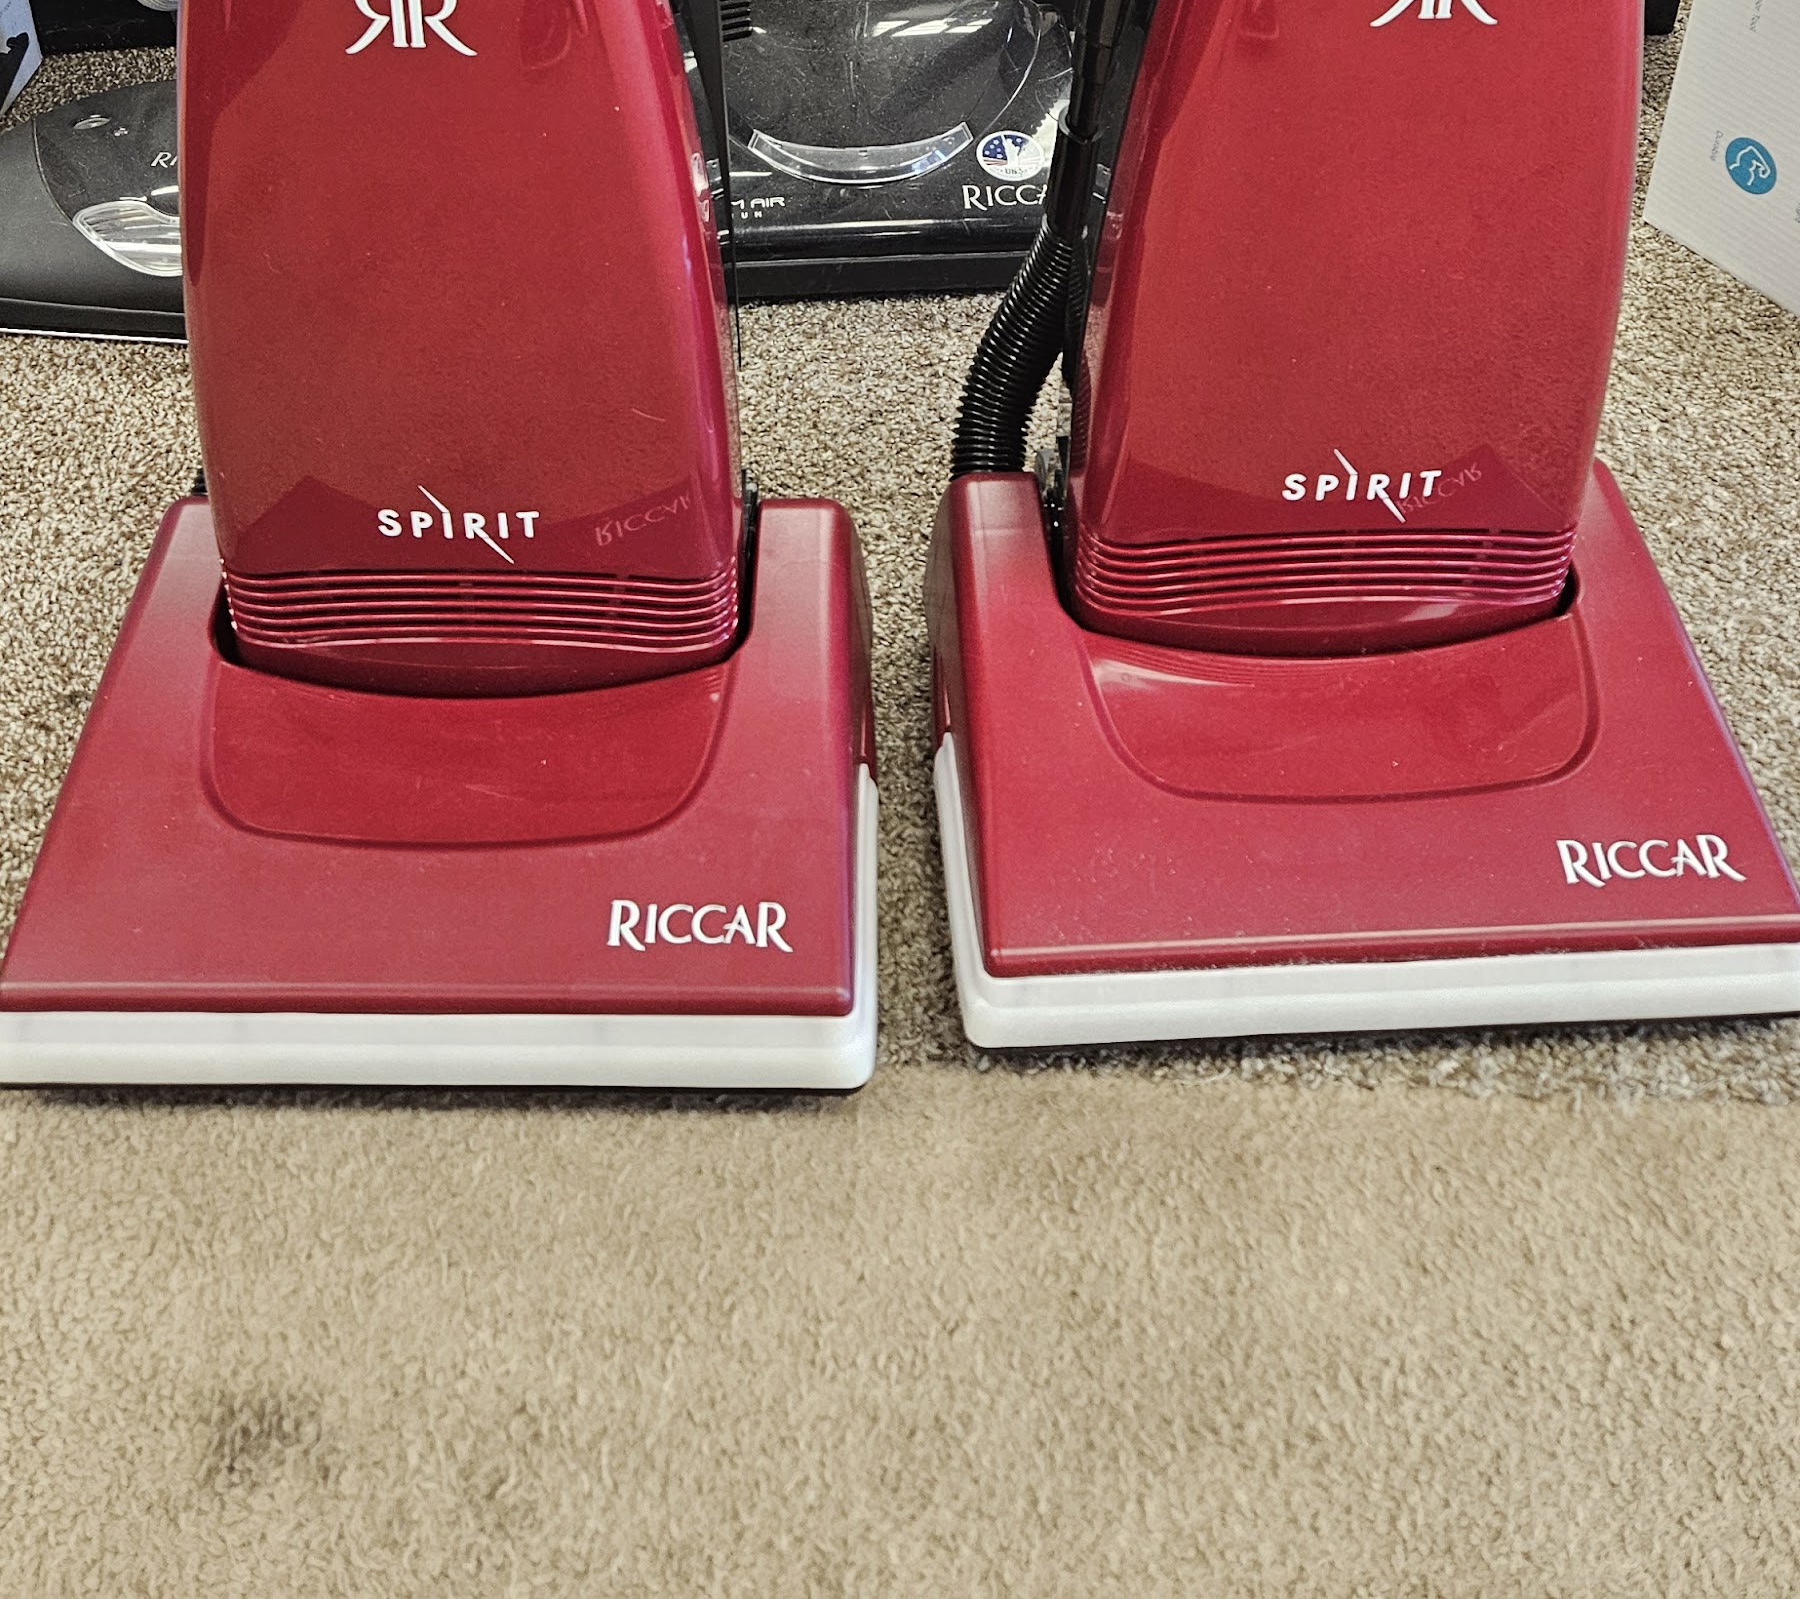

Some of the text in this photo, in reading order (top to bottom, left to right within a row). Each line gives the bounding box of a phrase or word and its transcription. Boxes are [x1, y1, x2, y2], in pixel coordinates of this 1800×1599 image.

[750, 196, 785, 209] AIR
[1282, 448, 1442, 523] SPIRIT
[1556, 834, 1747, 888] RICCAR
[606, 900, 794, 953] RICCAR
